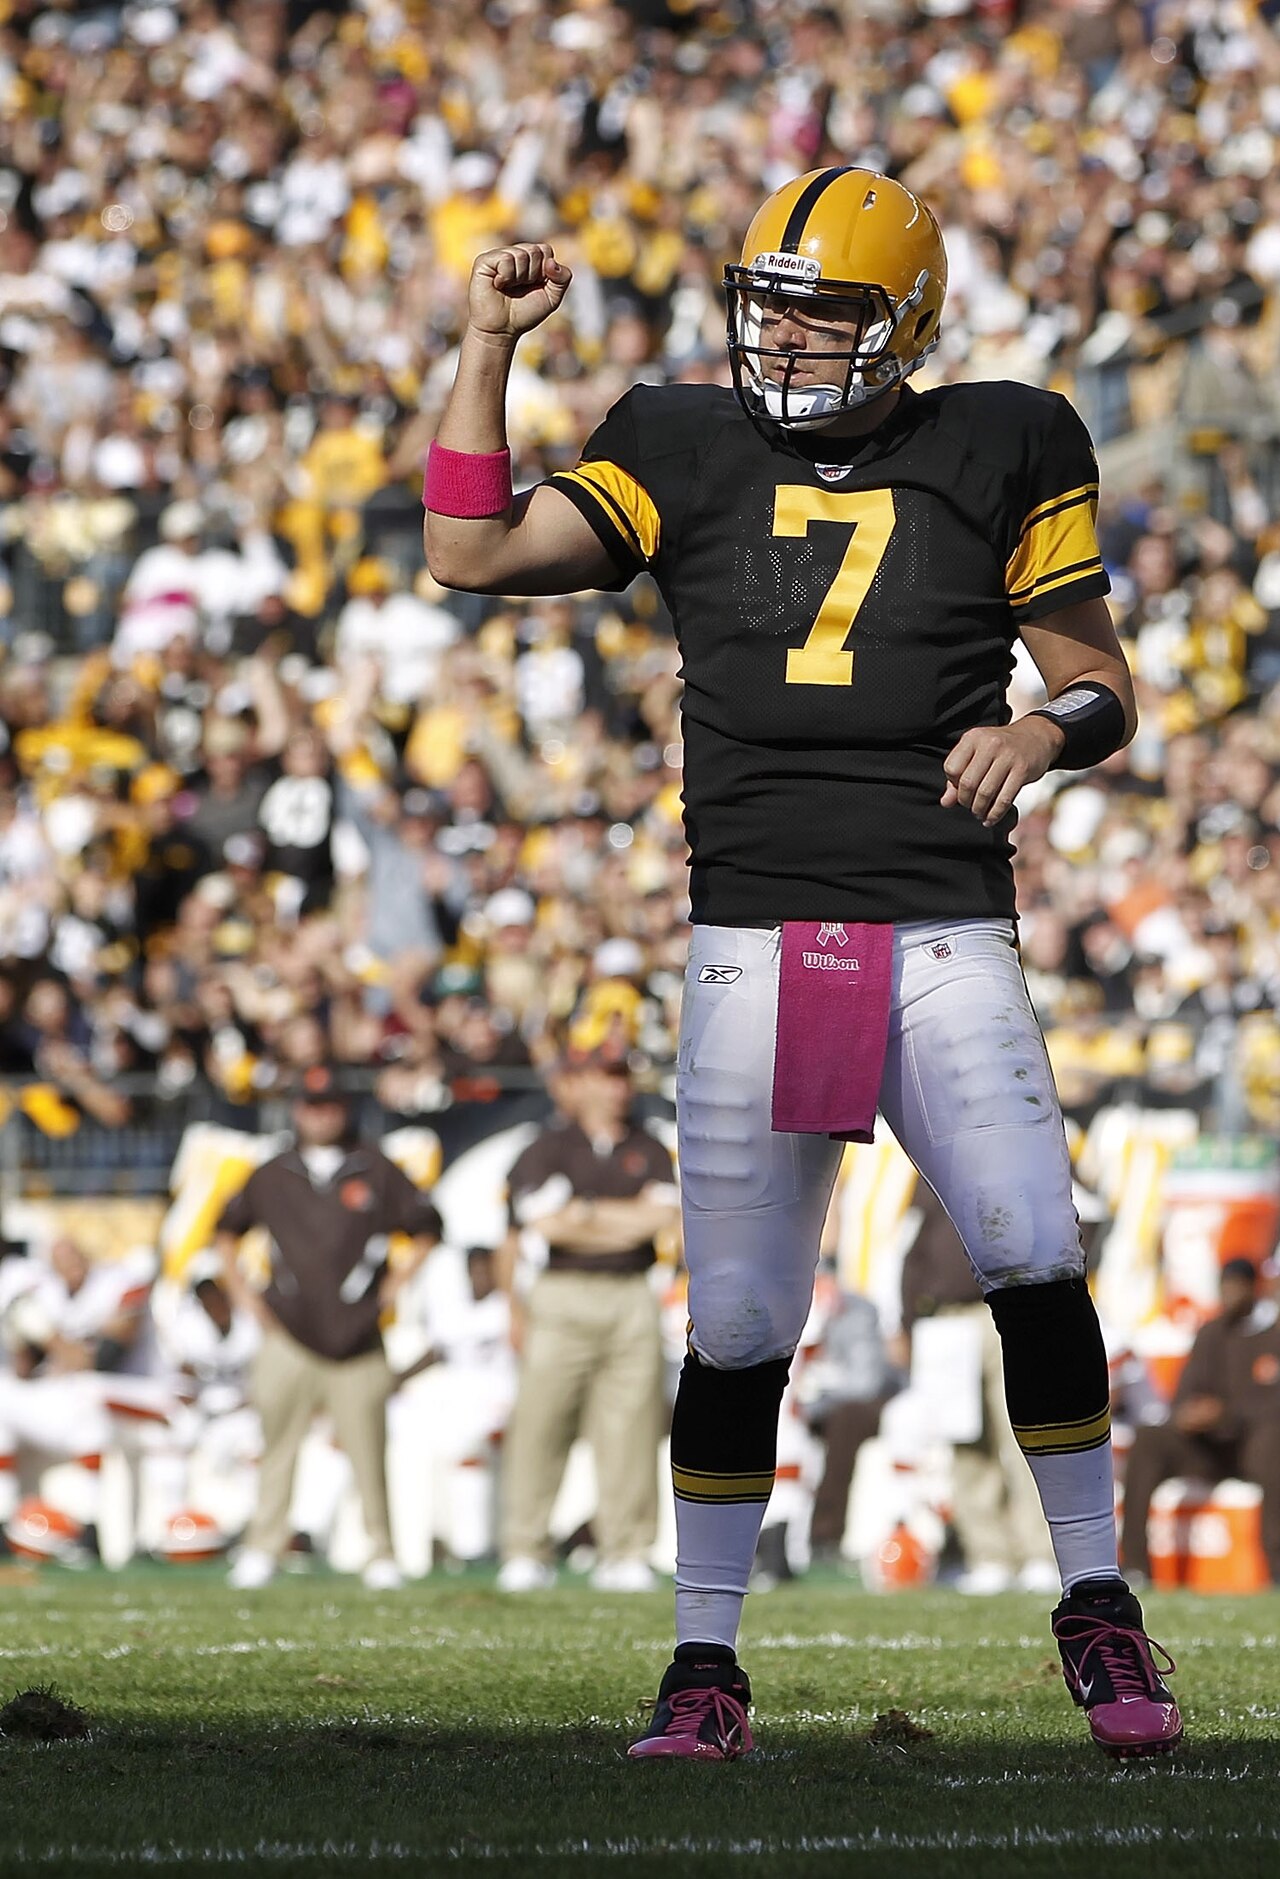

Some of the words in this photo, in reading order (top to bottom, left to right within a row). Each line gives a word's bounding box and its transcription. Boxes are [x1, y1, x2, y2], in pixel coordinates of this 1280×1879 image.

[767, 255, 806, 271] Riddell
[772, 484, 897, 685] 7
[802, 951, 860, 971] Wilson
